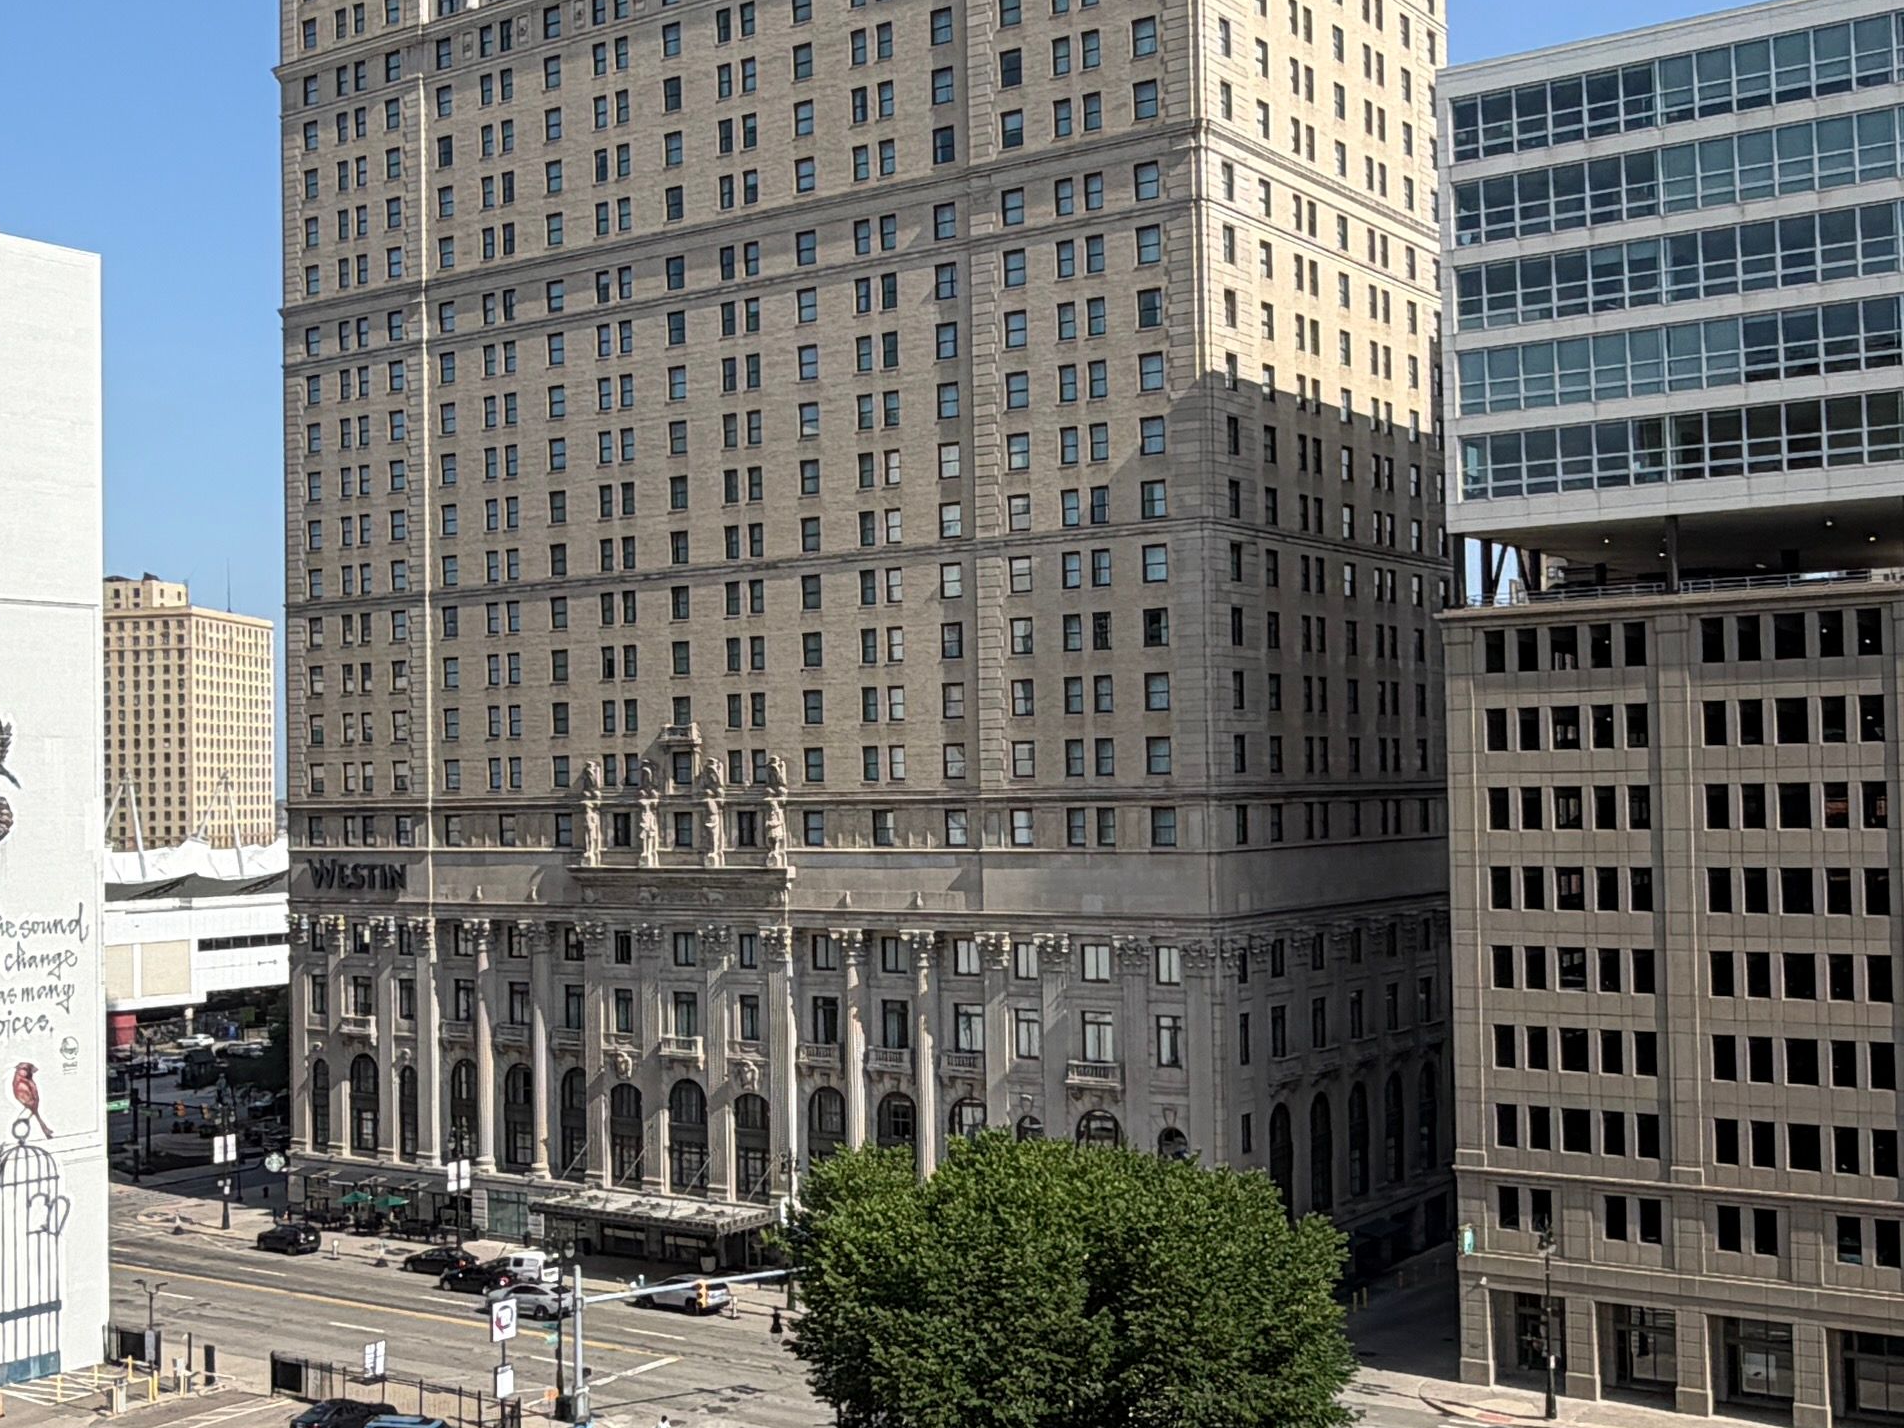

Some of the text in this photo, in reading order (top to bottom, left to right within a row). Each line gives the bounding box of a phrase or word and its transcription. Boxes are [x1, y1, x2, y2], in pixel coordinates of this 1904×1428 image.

[305, 858, 408, 890] WESTIN
[19, 902, 89, 943] sound
[4, 941, 78, 981] change
[21, 984, 75, 1014] many
